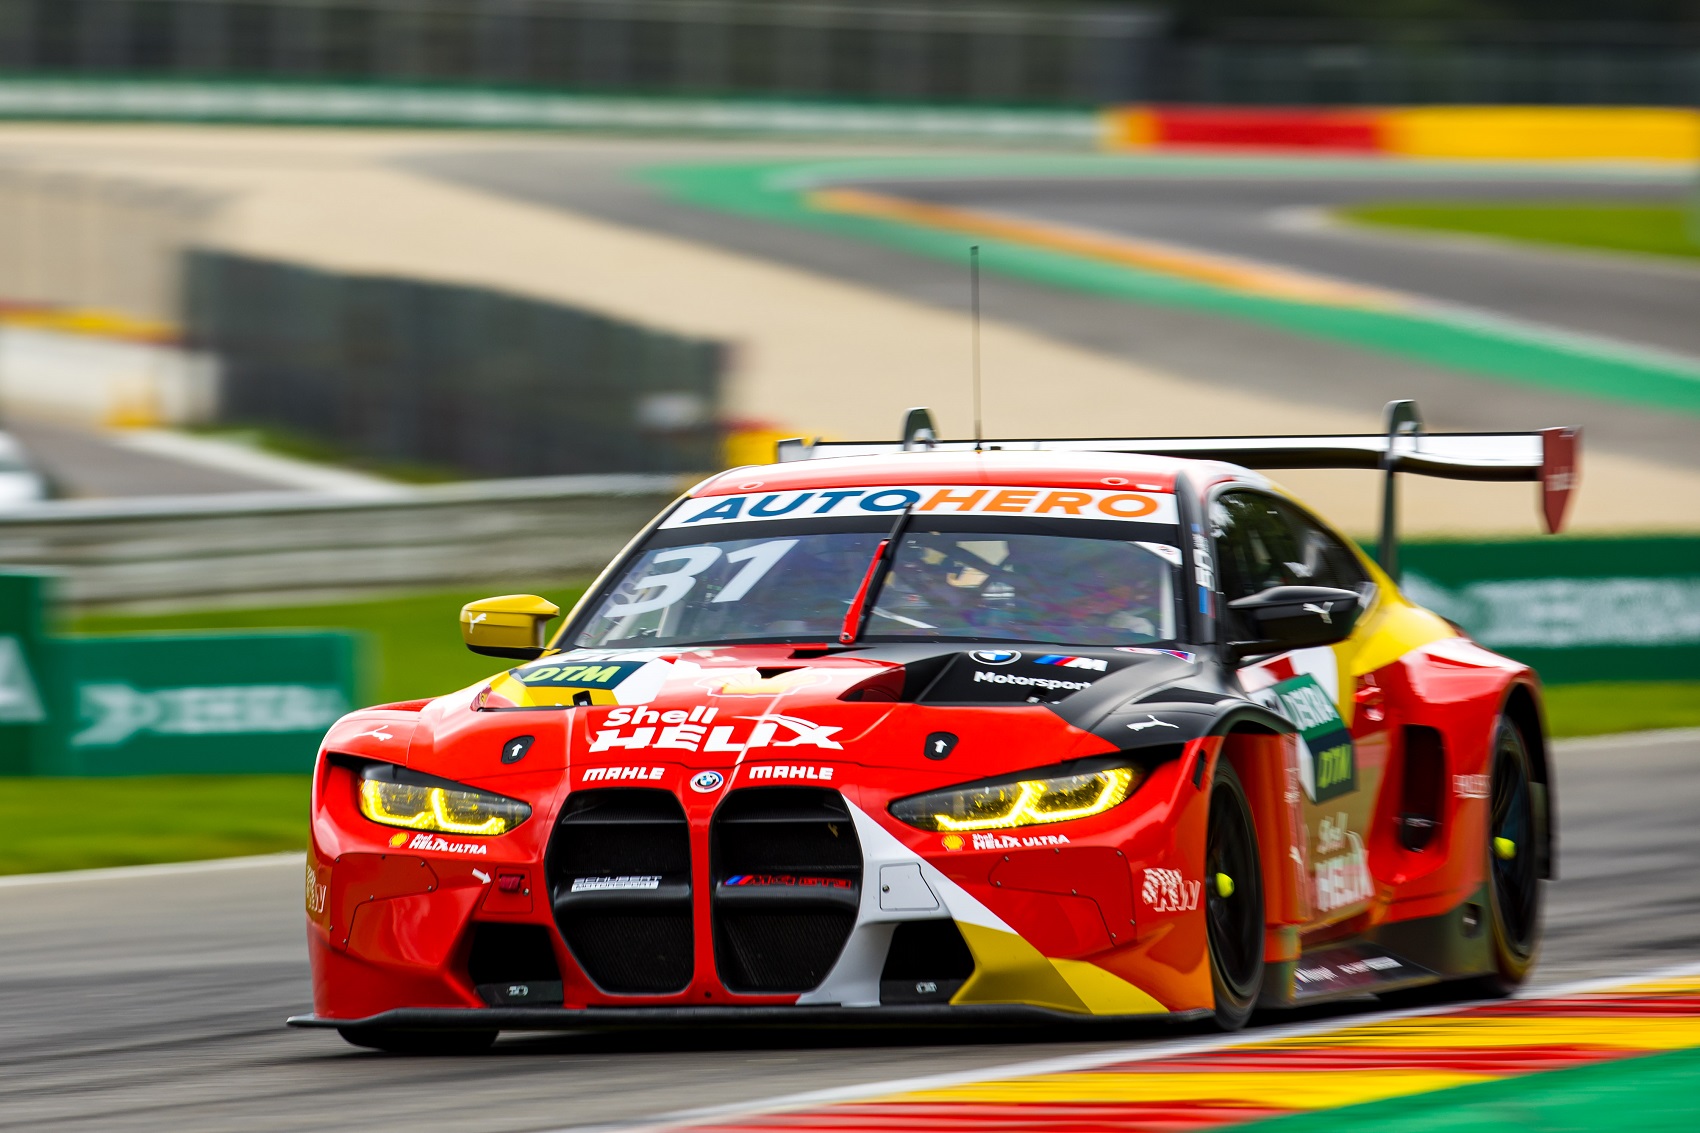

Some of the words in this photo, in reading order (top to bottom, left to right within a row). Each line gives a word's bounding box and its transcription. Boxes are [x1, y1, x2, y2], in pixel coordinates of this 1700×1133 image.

[681, 489, 1159, 524] AUTOHERO
[603, 539, 800, 618] 31
[522, 665, 622, 683] DTM
[973, 670, 1093, 690] Motorsport
[603, 705, 719, 727] Shell
[588, 714, 844, 753] HELIX
[582, 767, 665, 782] MAHLE
[749, 765, 834, 780] MAHLE
[408, 837, 449, 852] HELIX
[448, 842, 487, 855] ULTRA
[973, 834, 1023, 851] HELIX
[1022, 834, 1071, 847] ULTRA
